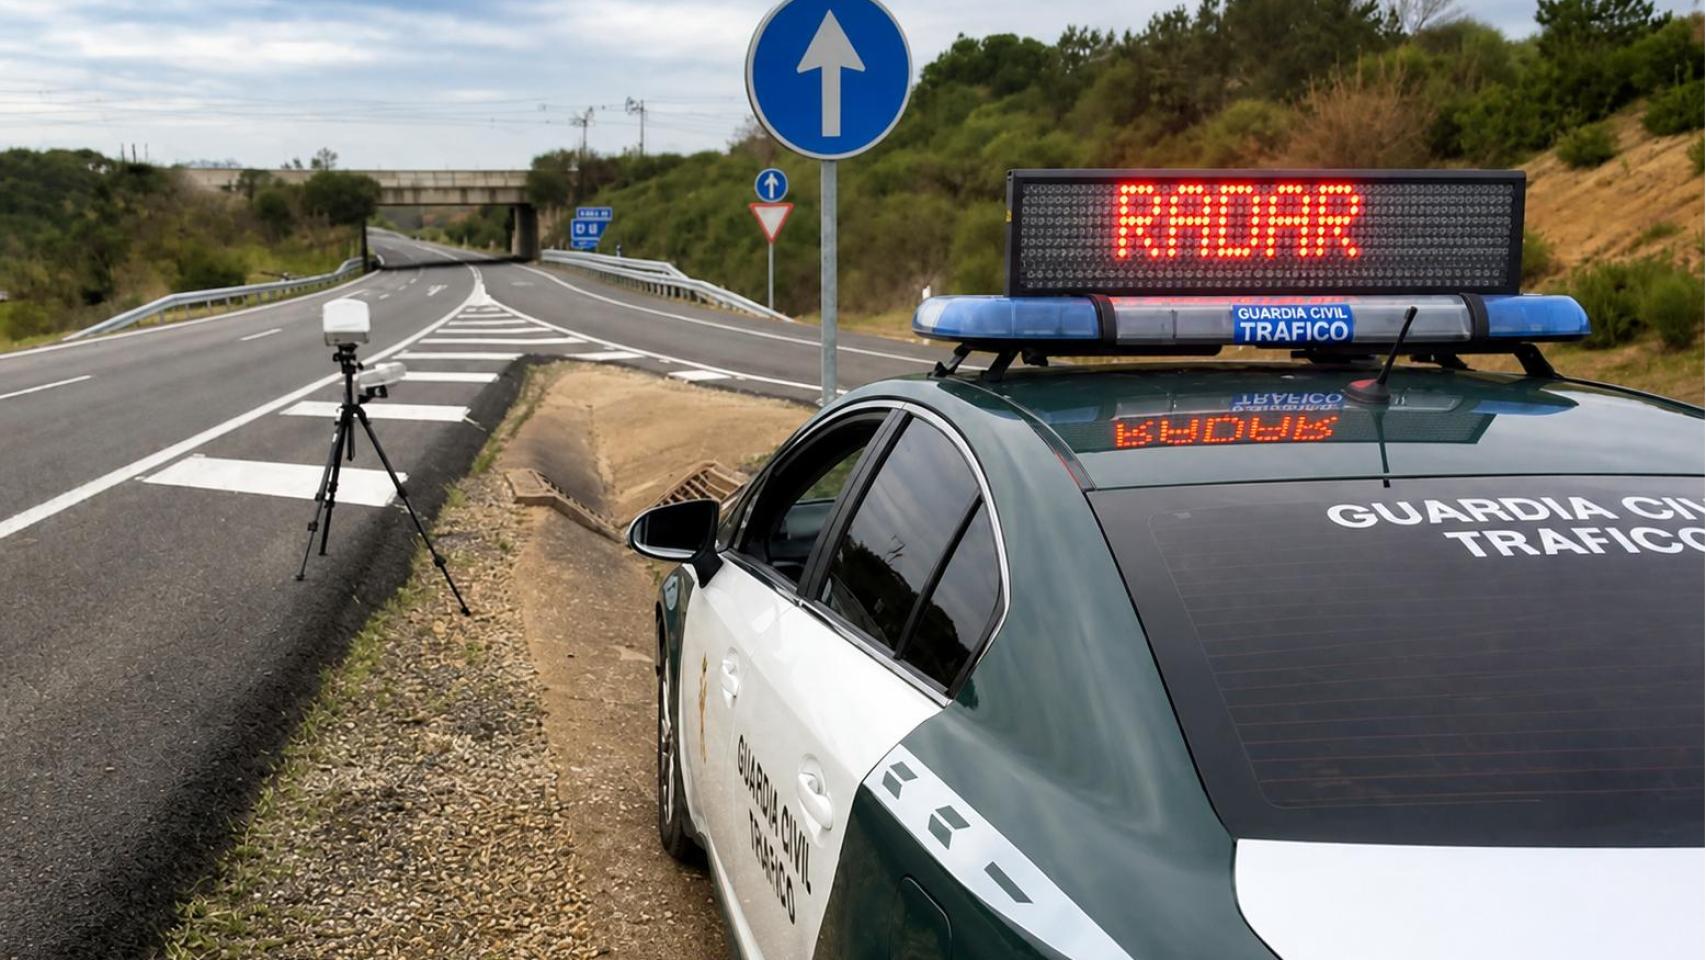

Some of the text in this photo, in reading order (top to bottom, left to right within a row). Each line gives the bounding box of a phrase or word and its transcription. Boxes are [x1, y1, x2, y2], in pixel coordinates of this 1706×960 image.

[1117, 183, 1361, 258] RADAR
[1238, 306, 1348, 319] GUARDIA CIVIL
[1240, 321, 1349, 341] TRAFICO
[1326, 496, 1620, 529] GUARDIA
[737, 734, 811, 896] GUARDIA CIVIL
[749, 807, 796, 926] TRAFICO
